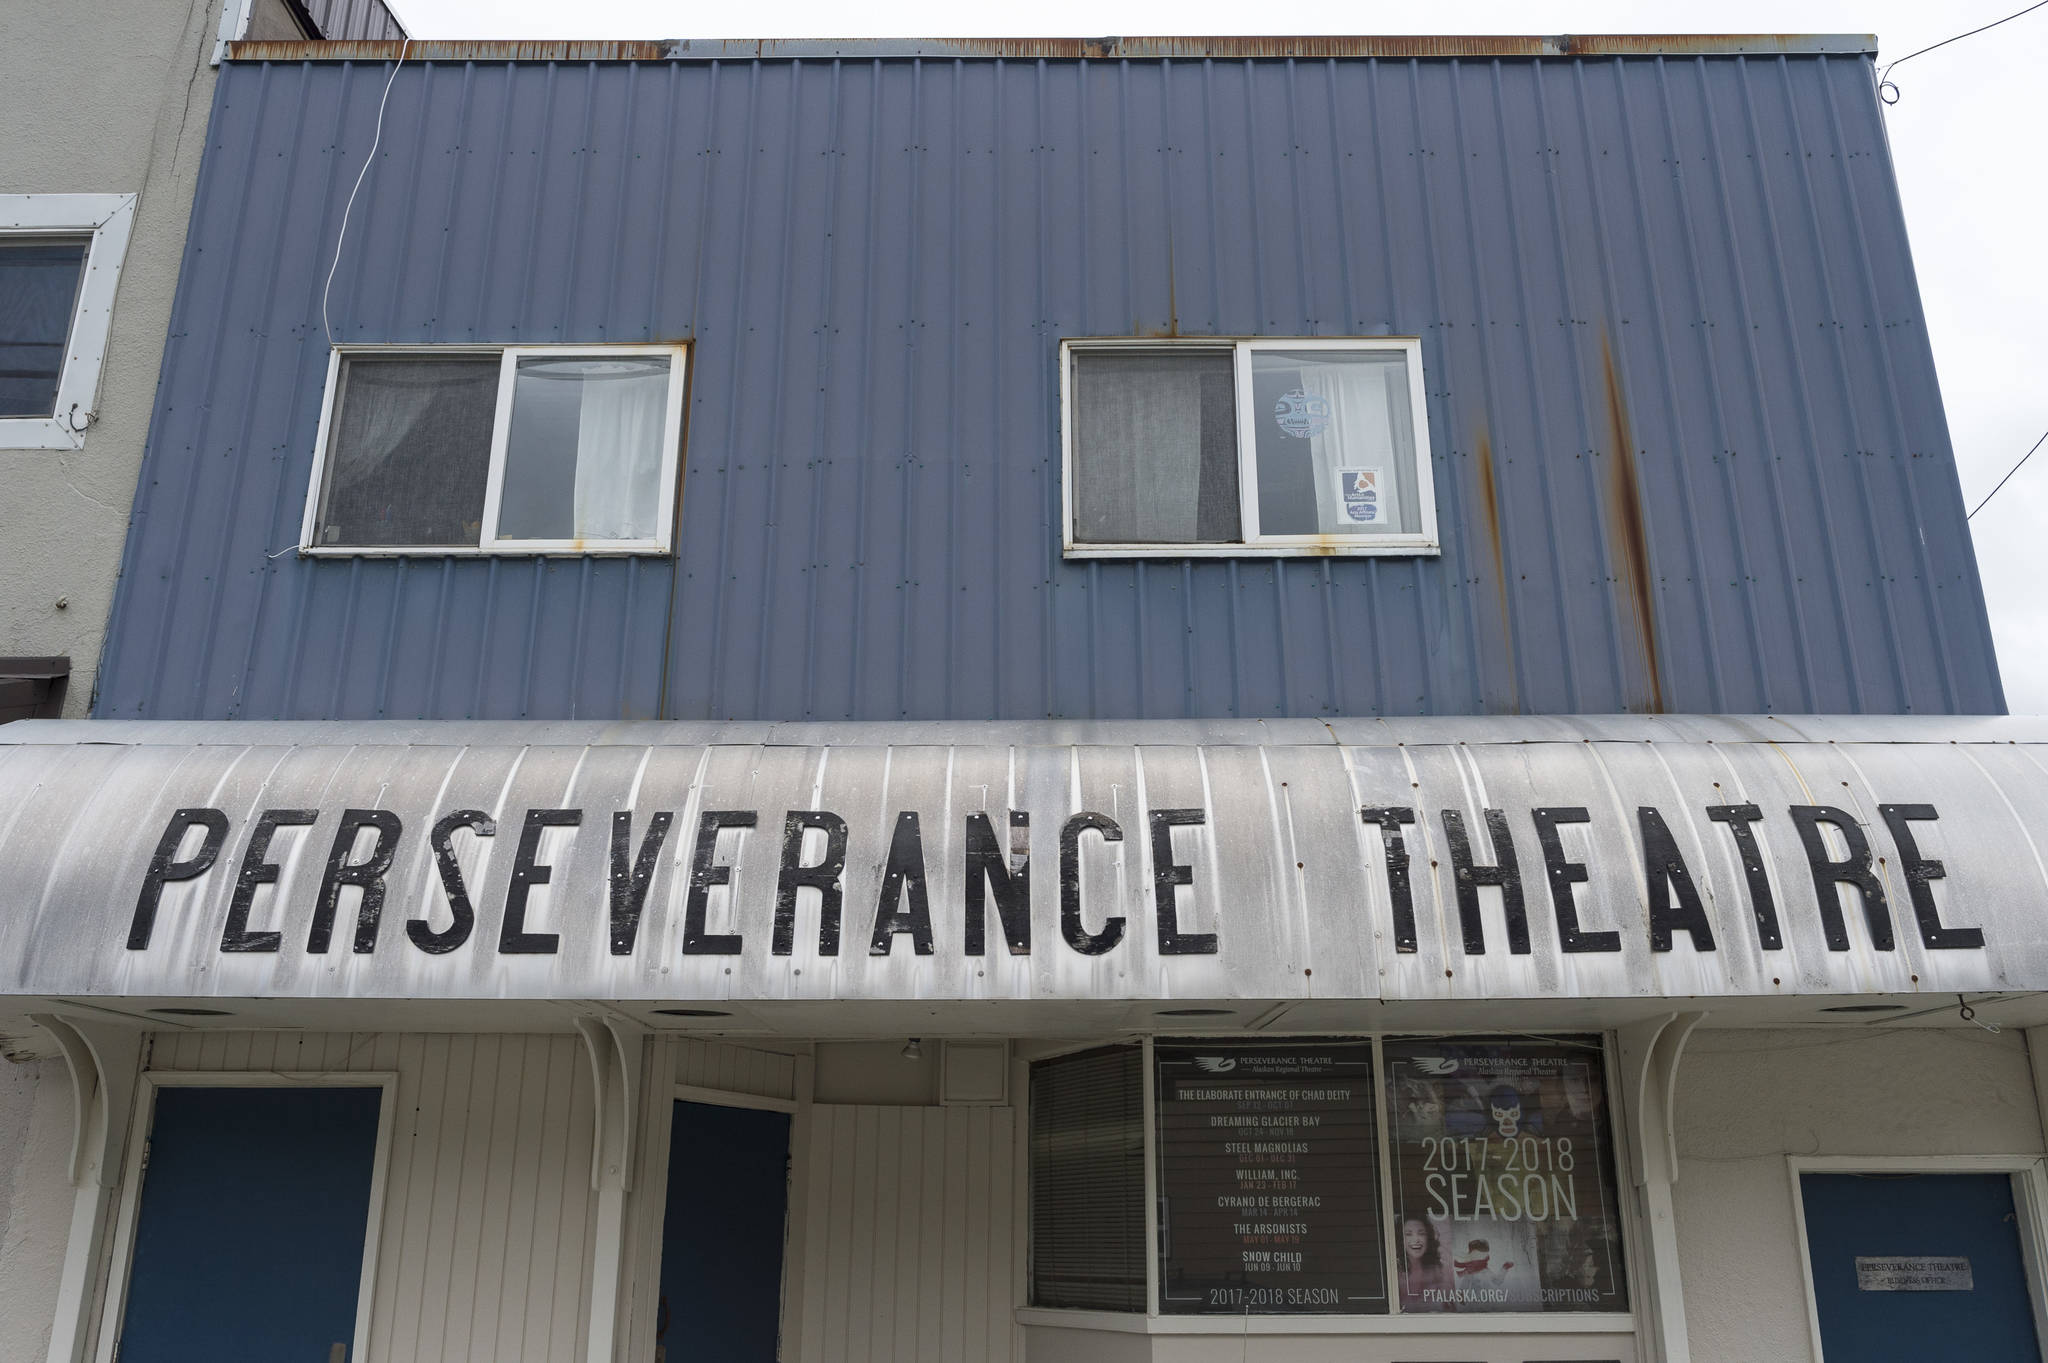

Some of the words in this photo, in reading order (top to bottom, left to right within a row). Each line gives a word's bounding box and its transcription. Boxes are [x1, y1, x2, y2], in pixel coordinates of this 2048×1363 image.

[126, 807, 1218, 957] PERSEVERANCE
[1361, 803, 1985, 955] THEATRE
[1240, 1057, 1297, 1065] PERSEVERANCE
[1300, 1057, 1333, 1065] THEATRE
[1464, 1057, 1528, 1066] PERSEVERANCE
[1532, 1057, 1568, 1066] THEATRE
[1275, 1066, 1300, 1074] Regional
[1179, 1090, 1194, 1100] THE
[1196, 1090, 1243, 1100] ELABORATE
[1245, 1090, 1287, 1100] ENTRANCE
[1289, 1090, 1300, 1100] OF
[1302, 1090, 1325, 1100] CHAD
[1327, 1090, 1350, 1100] DEITY
[1211, 1116, 1259, 1127] DREAMING
[1261, 1116, 1300, 1127] GLACIER
[1302, 1116, 1320, 1127] BAY
[1238, 1128, 1253, 1136] OCT
[1225, 1143, 1250, 1153] STEEL
[1254, 1143, 1308, 1153] MAGNOLIAS
[1239, 1154, 1254, 1163] DEC
[1271, 1154, 1285, 1163] DEC
[1421, 1136, 1575, 1172] 2017-2018
[1236, 1169, 1279, 1181] WILLIAM,
[1281, 1169, 1300, 1180] INC.
[1240, 1181, 1255, 1190] JAN
[1256, 1181, 1266, 1190] 23
[1273, 1181, 1287, 1190] FEB
[1289, 1181, 1297, 1190] 17
[1218, 1197, 1255, 1207] CYRANO
[1258, 1197, 1270, 1207] DE
[1272, 1197, 1321, 1207] BERGERAC
[1424, 1174, 1578, 1221] SEASON
[1241, 1208, 1258, 1216] MAR
[1273, 1208, 1289, 1216] APR
[1234, 1224, 1251, 1234] THE
[1254, 1224, 1307, 1234] ARSONISTS
[1243, 1235, 1258, 1244] MAY
[1274, 1235, 1289, 1244] MAY
[1243, 1251, 1271, 1263] SNOW
[1273, 1251, 1302, 1263] CHILD
[1245, 1263, 1259, 1272] JUN
[1260, 1263, 1271, 1272] 09
[1276, 1263, 1291, 1272] JUN
[1292, 1263, 1300, 1272] 10
[1861, 1263, 1927, 1271] PERSEVERANCE
[1928, 1263, 1968, 1271] THEATRE
[1210, 1288, 1283, 1305] 2017-2018
[1287, 1288, 1339, 1304] SEASON
